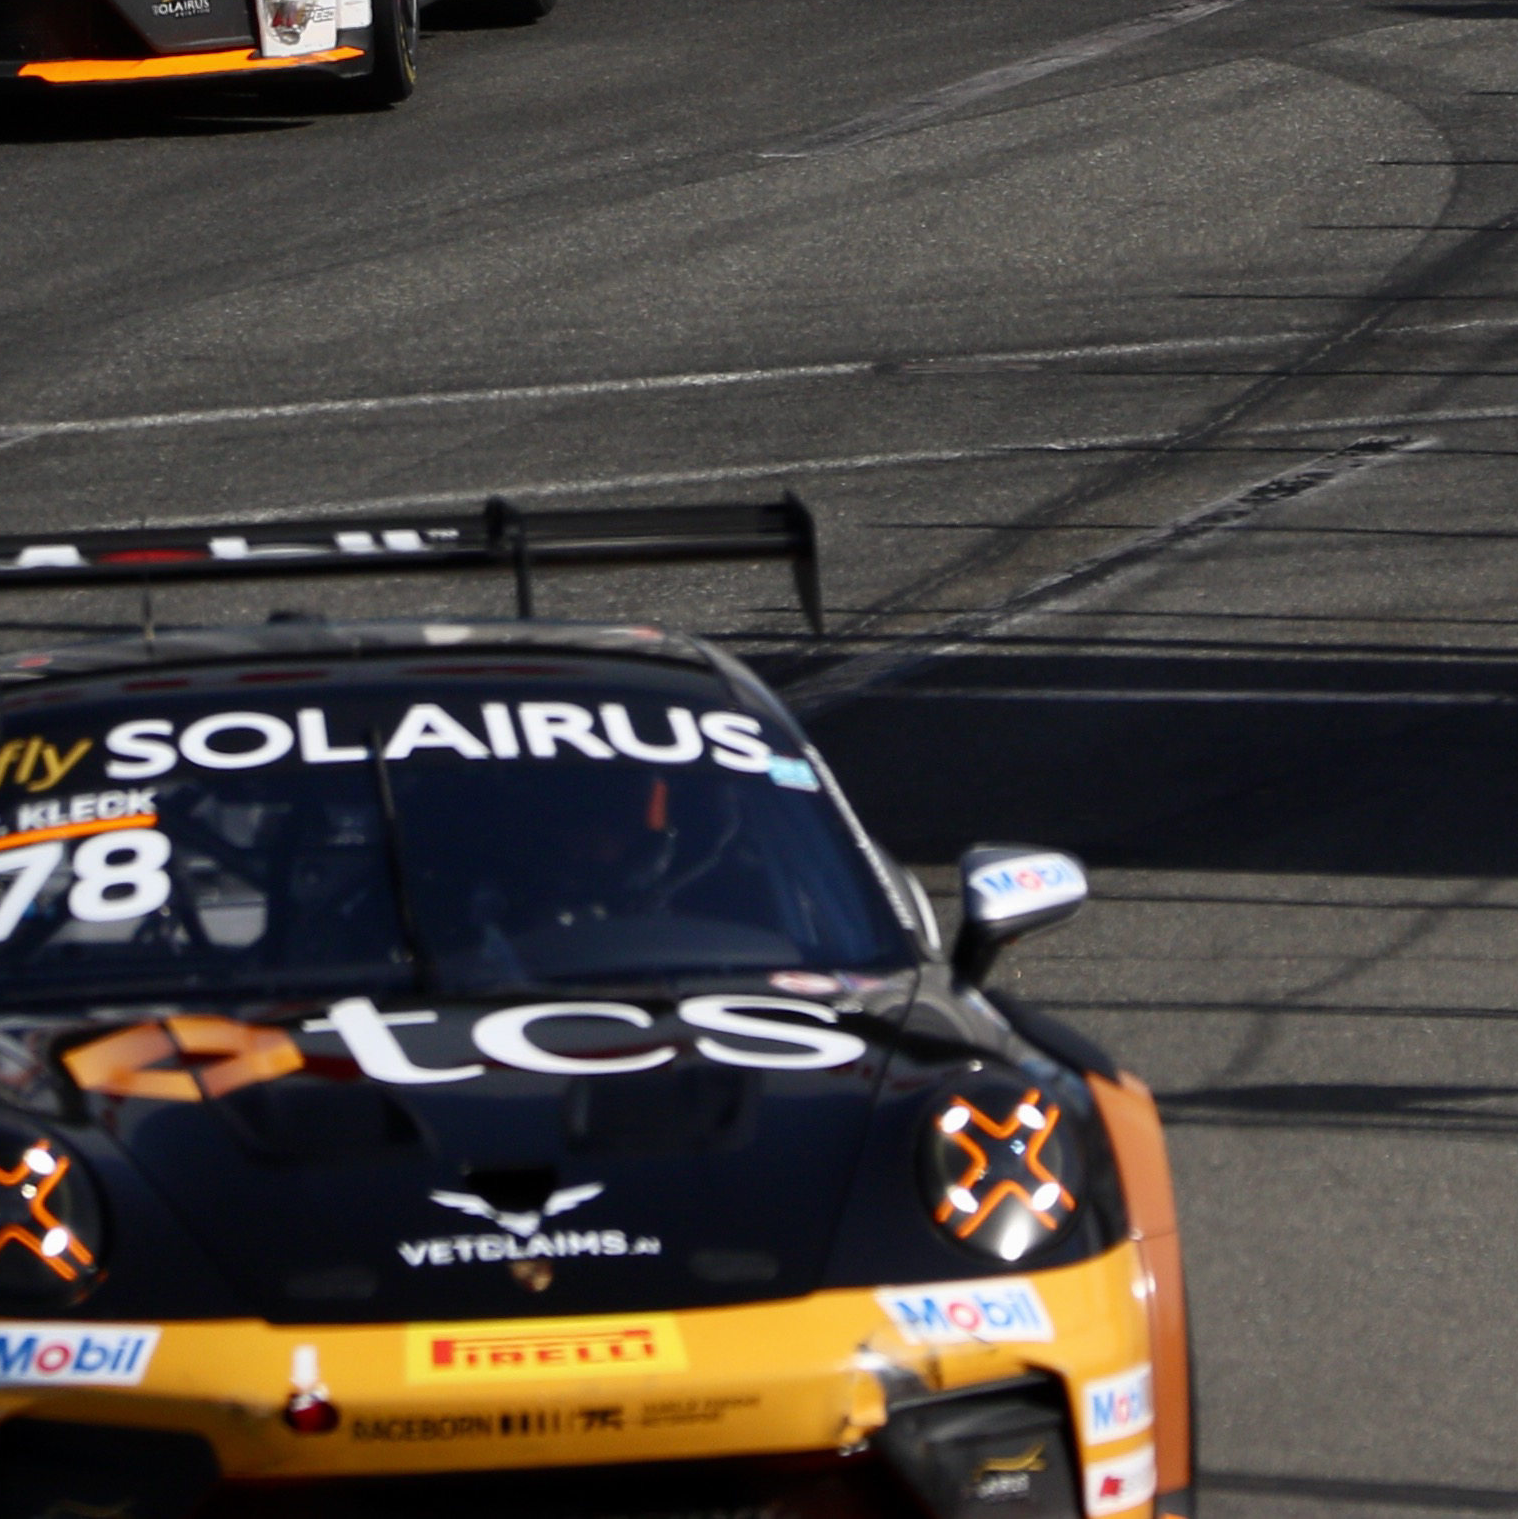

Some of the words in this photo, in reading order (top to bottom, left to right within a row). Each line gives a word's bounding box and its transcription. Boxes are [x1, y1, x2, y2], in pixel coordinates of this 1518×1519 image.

[104, 700, 773, 781] SOLAIRUS
[17, 787, 158, 832] KLECK
[301, 994, 867, 1084] tcs
[895, 1288, 1043, 1332] Mobil
[432, 1328, 655, 1368] PIRELLI
